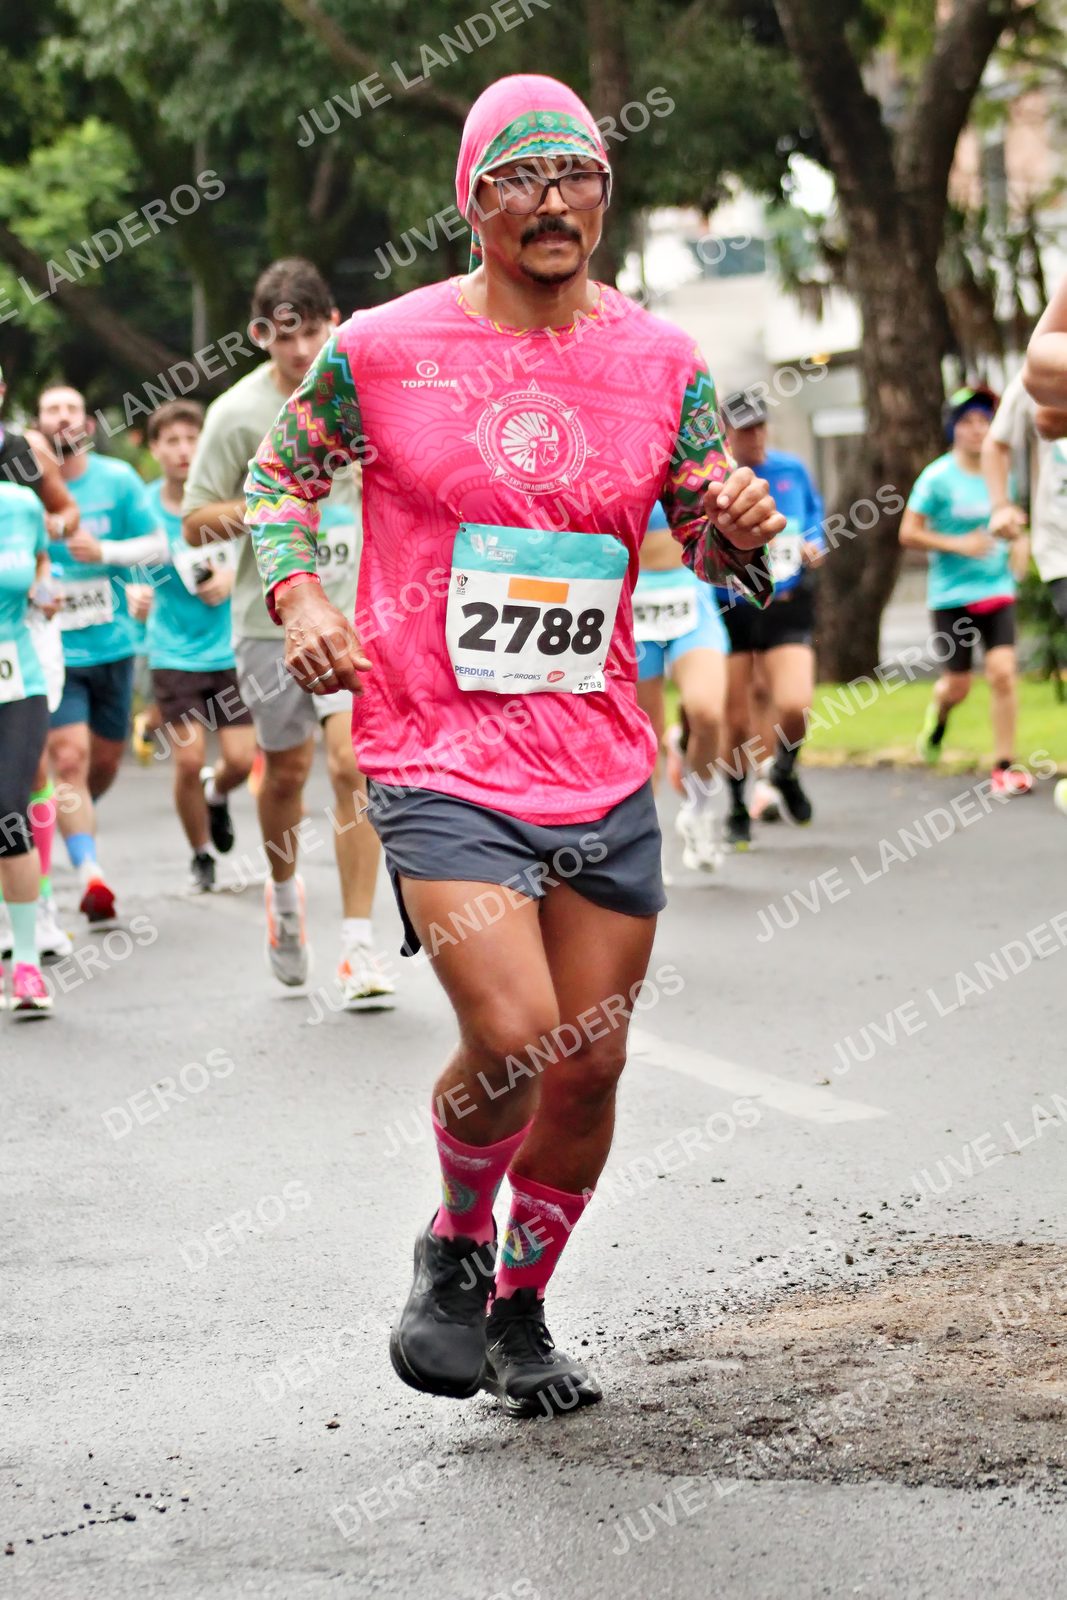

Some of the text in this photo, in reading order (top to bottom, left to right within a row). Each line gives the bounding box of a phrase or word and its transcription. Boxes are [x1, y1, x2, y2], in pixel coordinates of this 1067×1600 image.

[401, 379, 458, 389] TOPTIME
[458, 602, 604, 655] 2788
[455, 665, 495, 678] PERDURA
[513, 673, 542, 681] BROOKS
[578, 681, 602, 691] 2788
